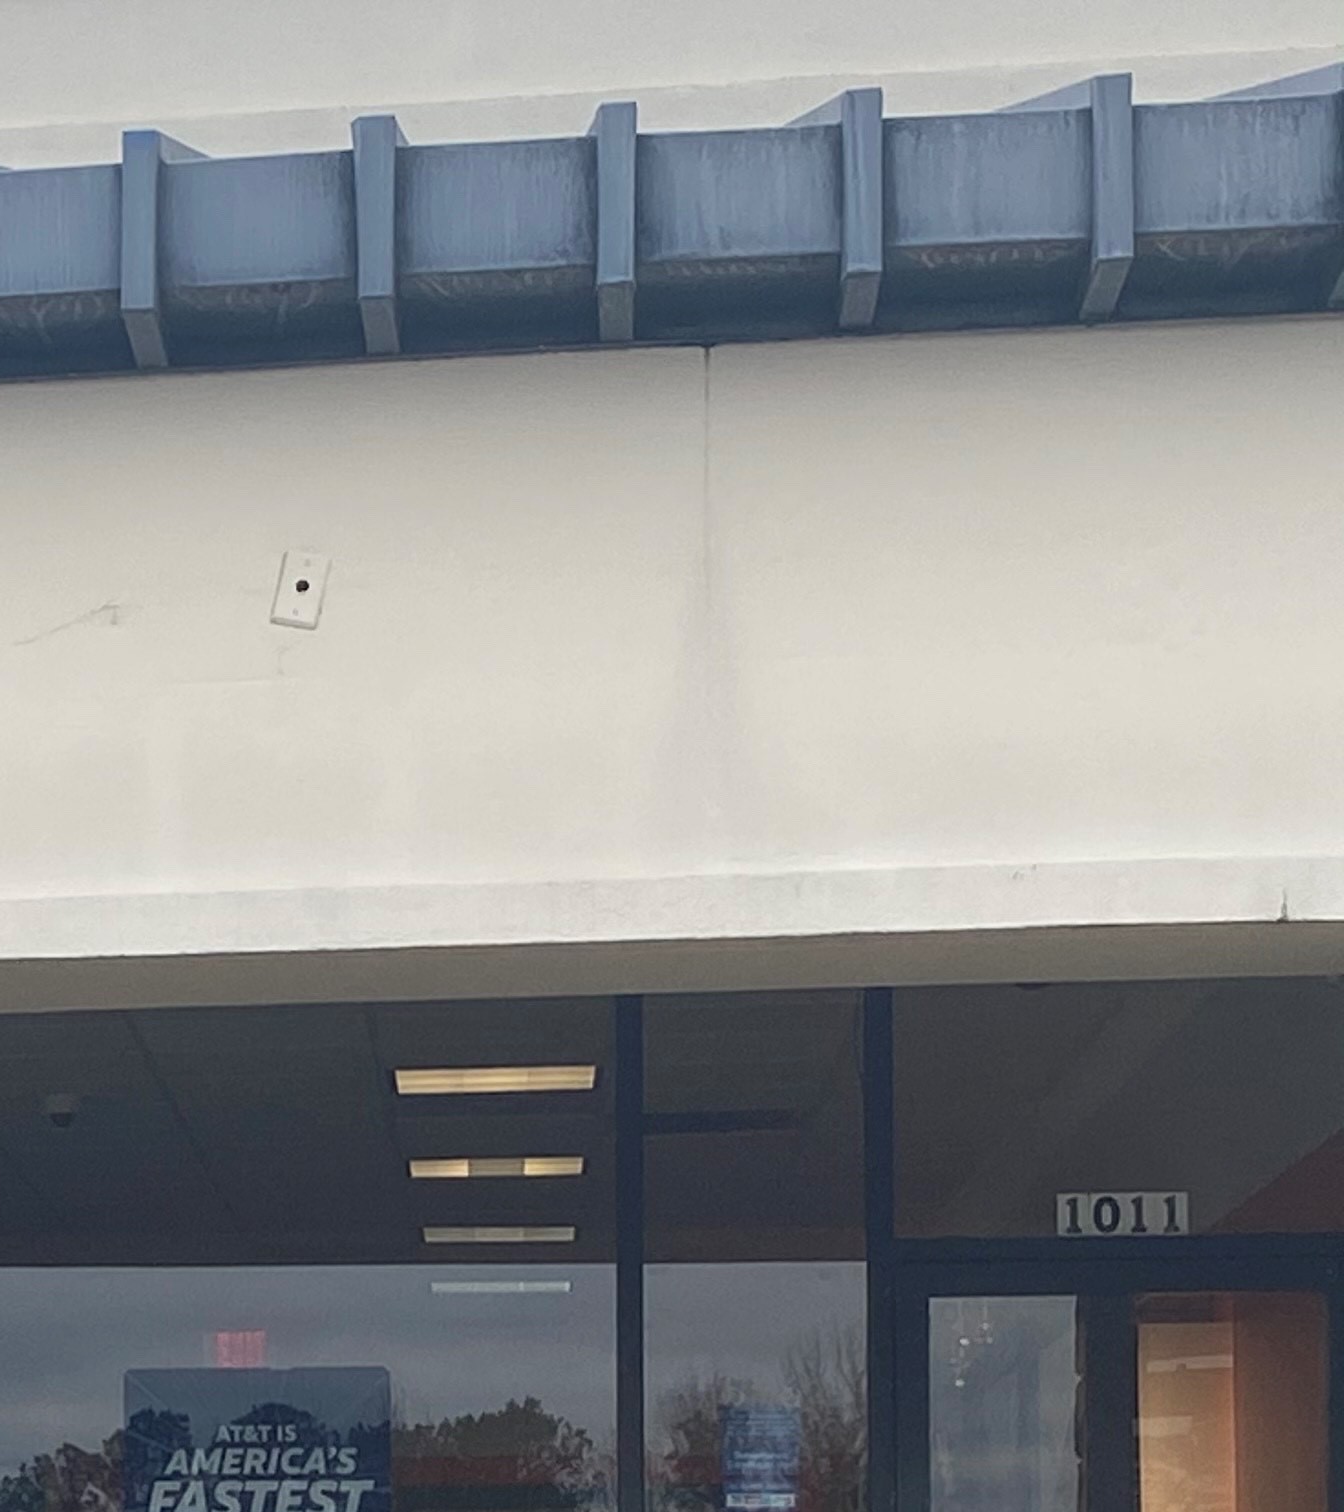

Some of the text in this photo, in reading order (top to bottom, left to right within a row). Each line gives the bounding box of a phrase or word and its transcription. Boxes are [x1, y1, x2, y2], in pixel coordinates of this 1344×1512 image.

[1064, 1195, 1181, 1233] 1011
[215, 1424, 298, 1443] AT&T IS
[163, 1446, 358, 1476] AMERICA'S
